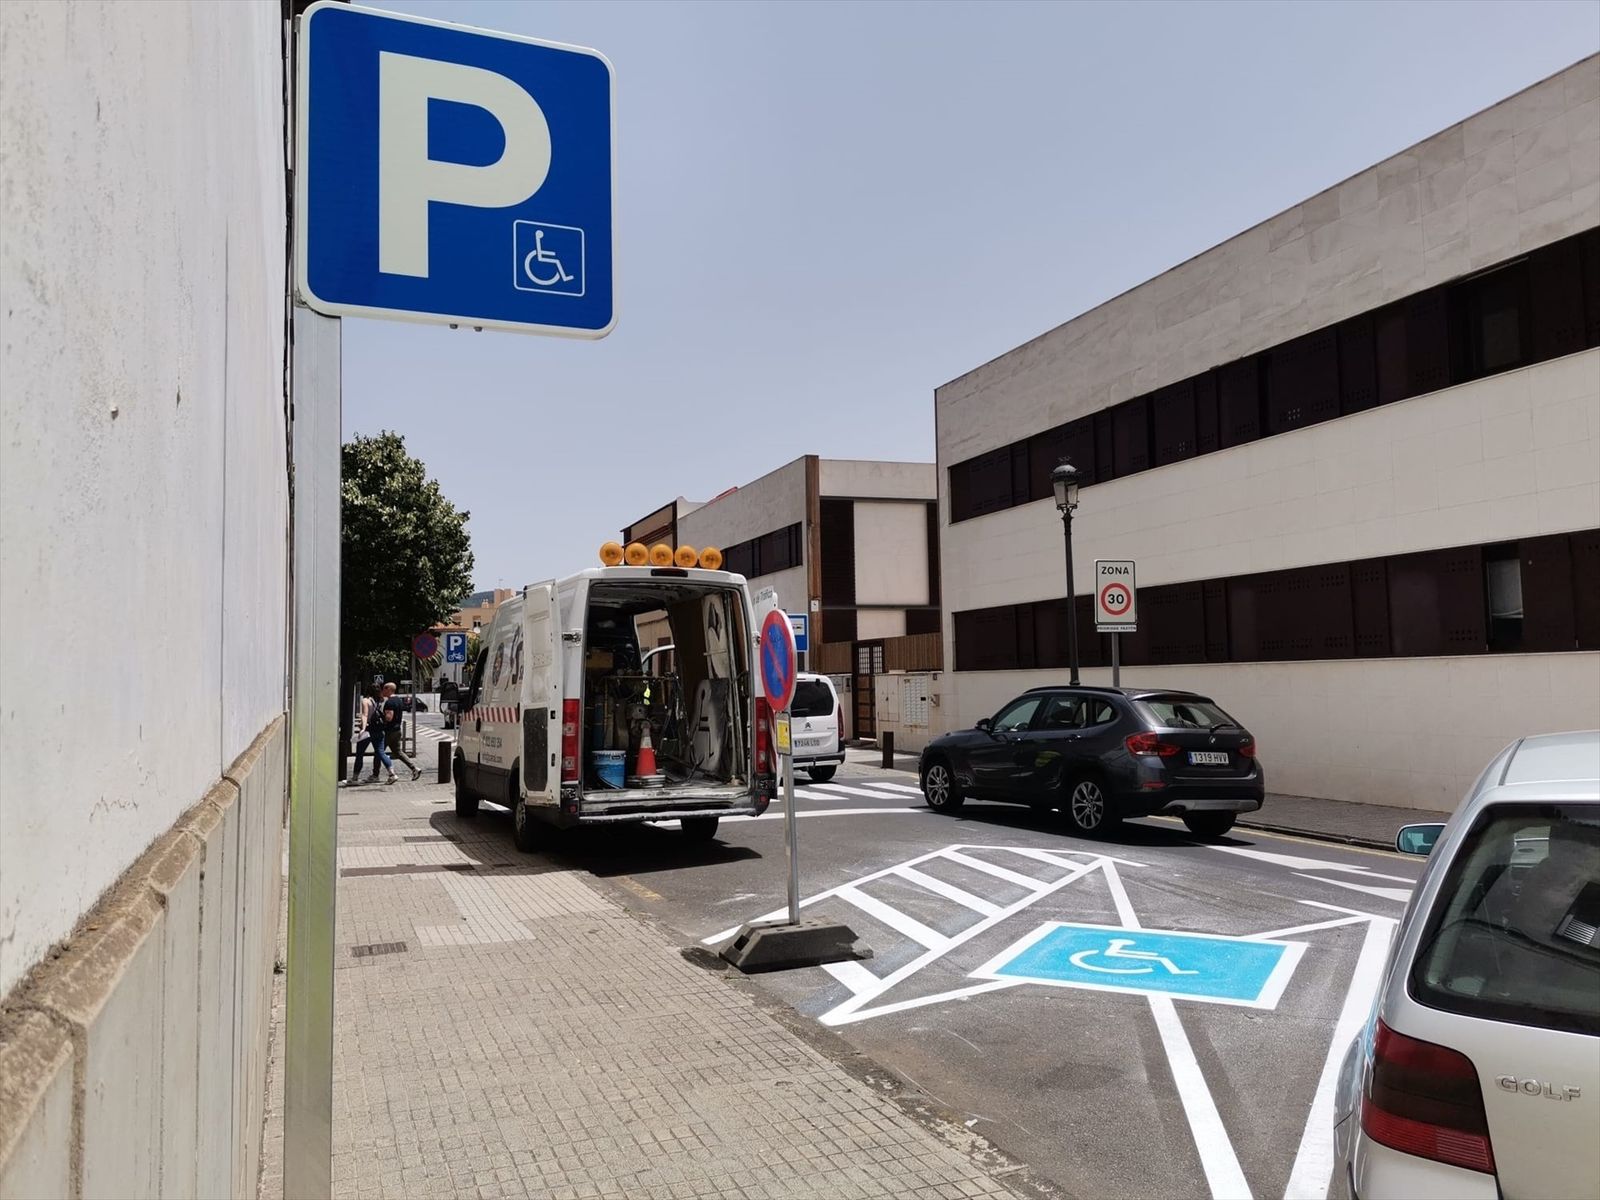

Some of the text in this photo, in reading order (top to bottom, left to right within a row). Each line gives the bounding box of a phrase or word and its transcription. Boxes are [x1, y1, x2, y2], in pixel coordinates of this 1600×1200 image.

[379, 50, 551, 278] P
[1101, 566, 1130, 575] ZONA
[1107, 593, 1125, 605] 30
[449, 635, 463, 652] P
[1194, 752, 1228, 763] 1319 HVV
[1495, 1074, 1581, 1102] GOLF
